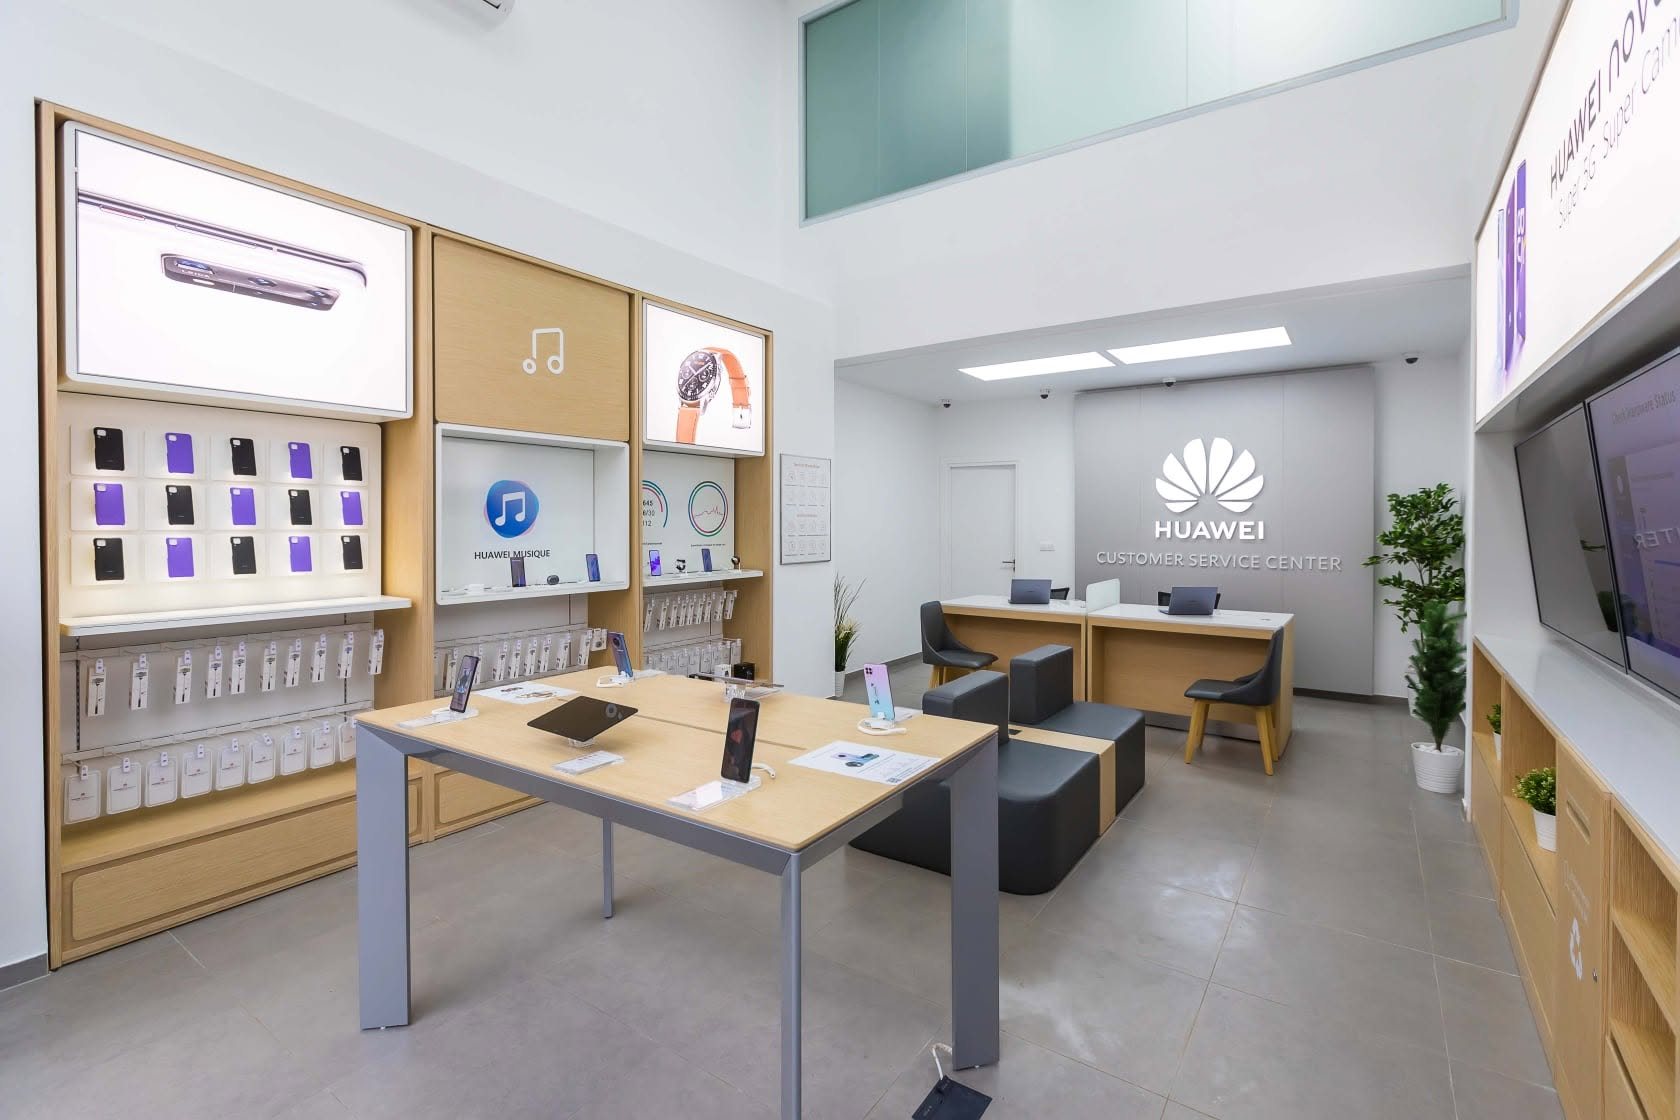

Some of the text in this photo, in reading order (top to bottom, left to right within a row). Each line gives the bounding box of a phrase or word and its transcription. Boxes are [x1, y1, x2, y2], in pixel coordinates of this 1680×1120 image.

[1550, 0, 1661, 200] HUAWEI nov
[1583, 144, 1596, 191] 5G
[1603, 80, 1637, 159] Super
[1641, 17, 1680, 95] Cam
[1155, 520, 1265, 541] HUAWEI
[474, 549, 551, 560] HUAWEI MUSIQUE
[1096, 551, 1343, 572] CUSTOMER SERVICE CENTER
